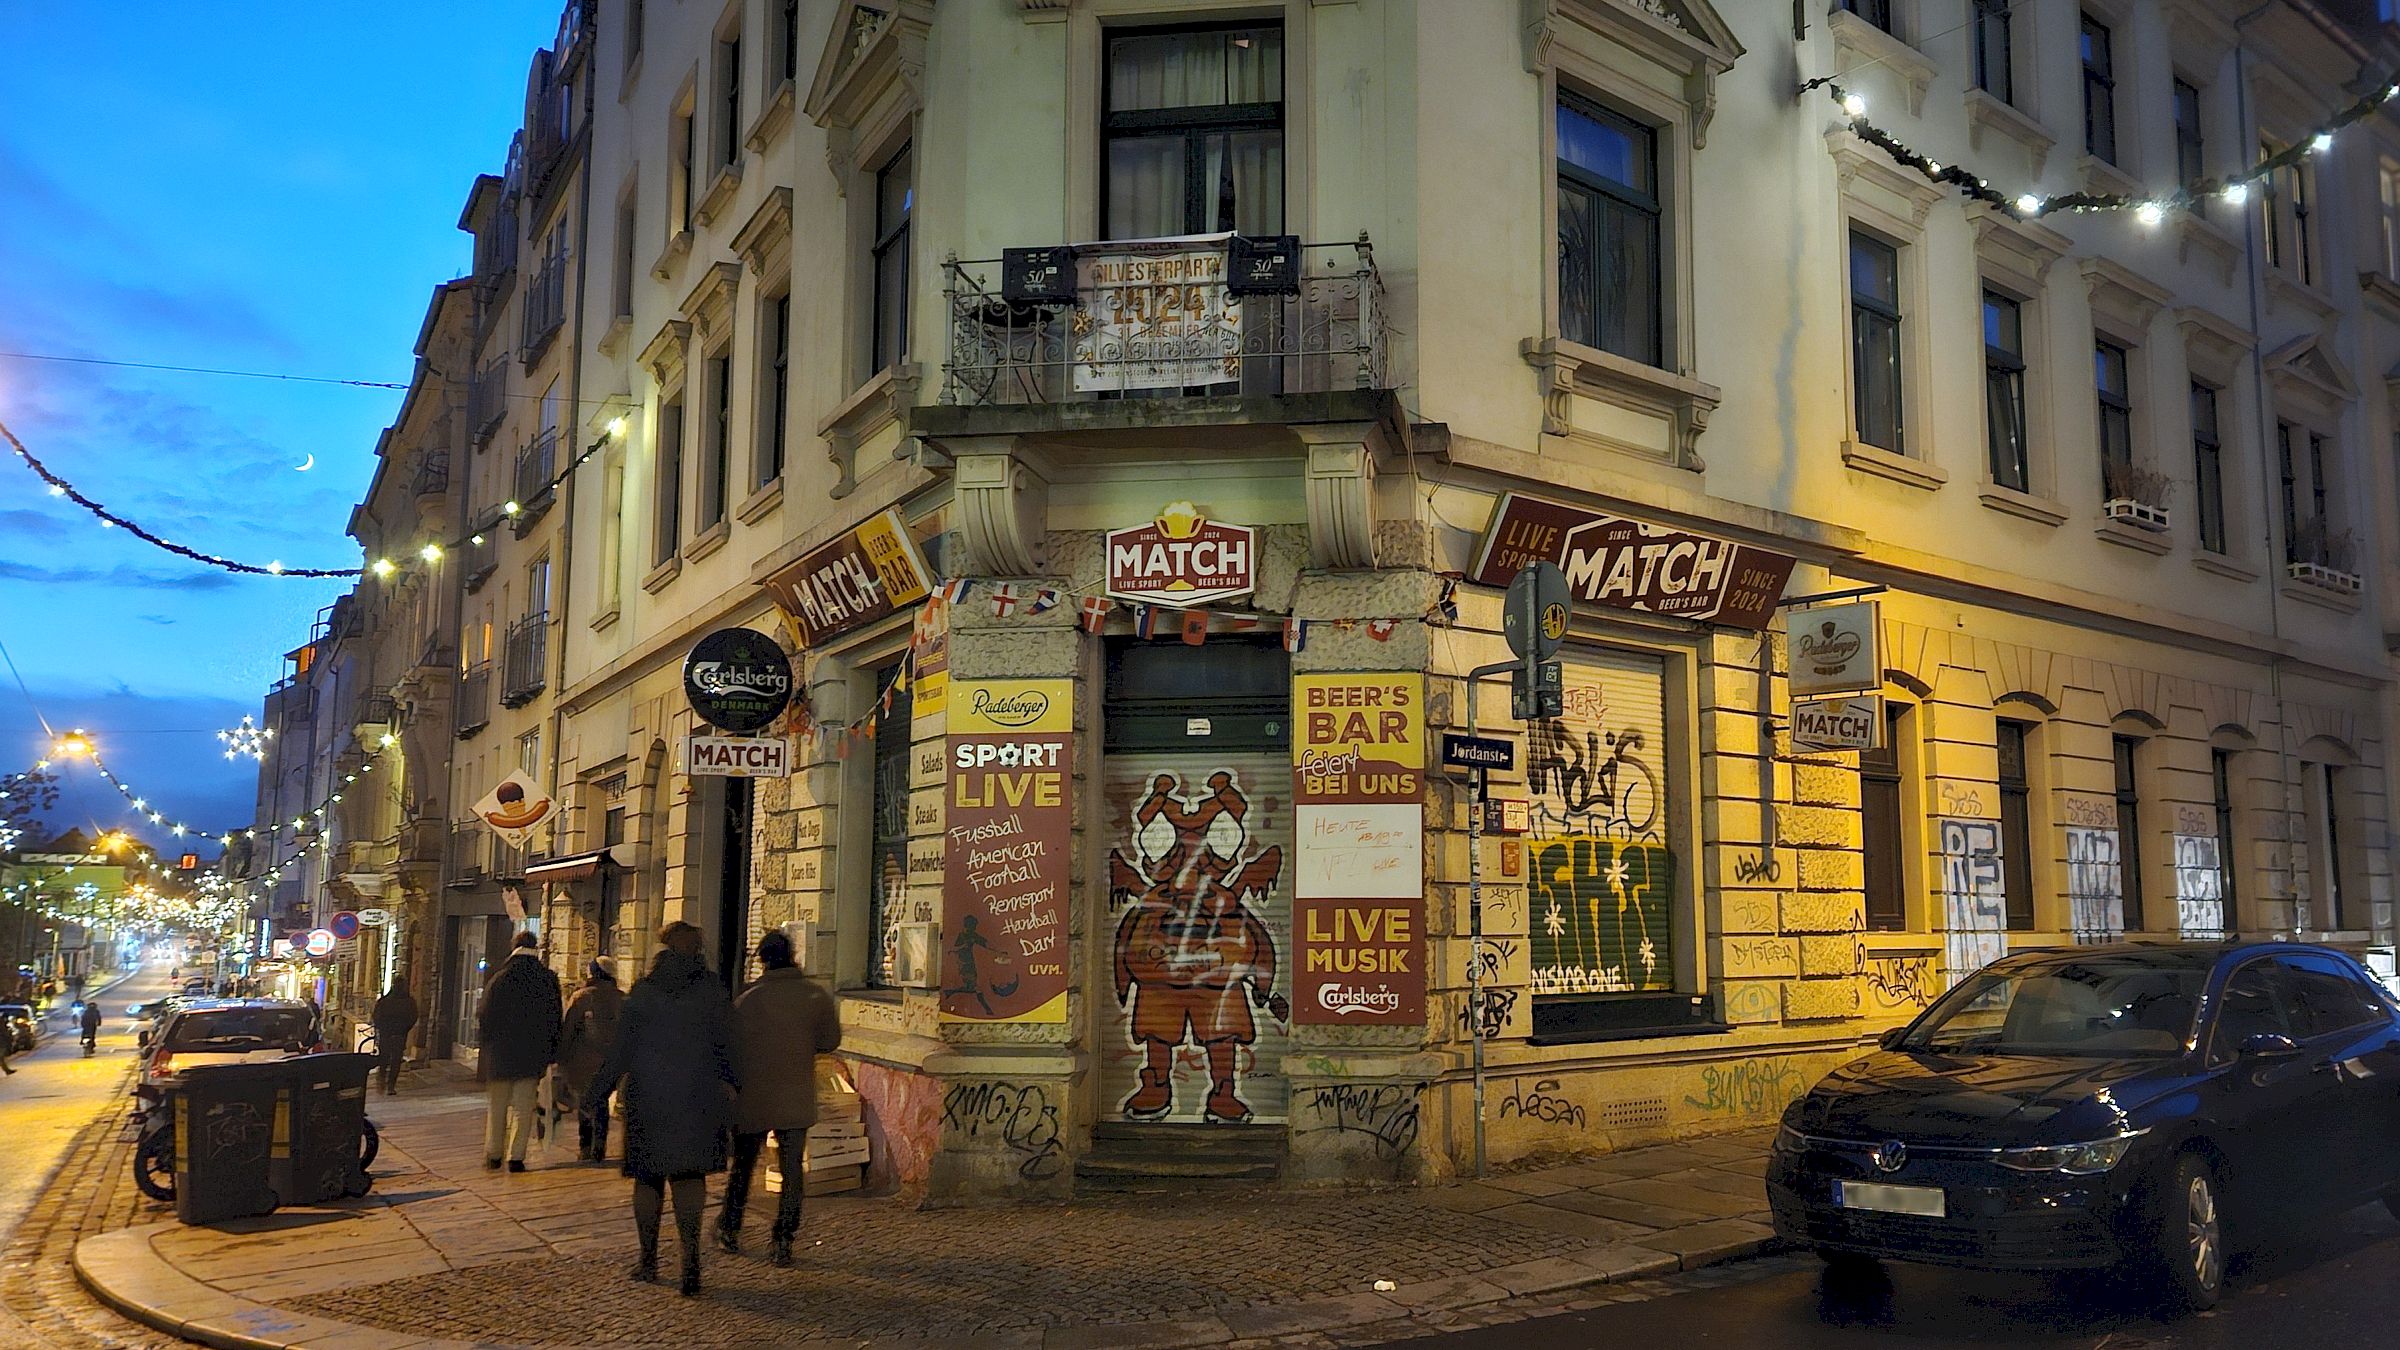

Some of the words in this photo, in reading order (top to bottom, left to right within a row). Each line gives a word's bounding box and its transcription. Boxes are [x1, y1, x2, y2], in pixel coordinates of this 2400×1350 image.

[1095, 255, 1223, 283] SILVESTERPARTY
[1113, 284, 1206, 325] 2024
[1139, 533, 1158, 541] SINCE
[1204, 531, 1220, 539] 2024
[1506, 519, 1558, 553] LIVE
[1608, 529, 1633, 542] SINCE
[1113, 541, 1246, 578] MATCH
[1498, 549, 1546, 571] SPO
[1564, 540, 1727, 601] MATCH
[880, 554, 920, 596] BAR
[1119, 580, 1136, 589] LIVE
[1139, 579, 1162, 588] SPORT
[1198, 577, 1224, 586] BEER'S
[1226, 577, 1241, 586] BAR
[1739, 568, 1777, 591] SINCE
[792, 552, 880, 632] MATCH
[1658, 597, 1690, 611] BEER'S
[1692, 595, 1708, 608] BAR
[1729, 589, 1767, 613] 2024
[692, 661, 788, 697] Carlsberg
[711, 699, 770, 712] DENMARK
[971, 689, 1049, 722] Radeberger
[1307, 686, 1410, 708] BEER'S
[1308, 711, 1409, 744] BAR
[1798, 713, 1869, 738] MATCH
[694, 744, 781, 767] MATCH
[921, 753, 943, 776] Salads
[1296, 743, 1361, 785] feiert
[956, 773, 1062, 808] LIVE
[1306, 774, 1349, 795] BEI
[1359, 773, 1417, 795] UNS
[915, 803, 938, 826] Steaks
[1314, 816, 1371, 837] HEUTE
[949, 813, 1024, 849] Fussball
[966, 838, 1046, 871] American
[967, 858, 1042, 894] Football
[983, 881, 1056, 916] Rennsport
[1001, 909, 1059, 936] Handball
[1306, 908, 1411, 942] LIVE
[1019, 930, 1057, 957] Dart
[1029, 964, 1064, 976] UVM.
[1307, 948, 1411, 973] MUSIK
[1318, 982, 1400, 1016] Carlsberg
